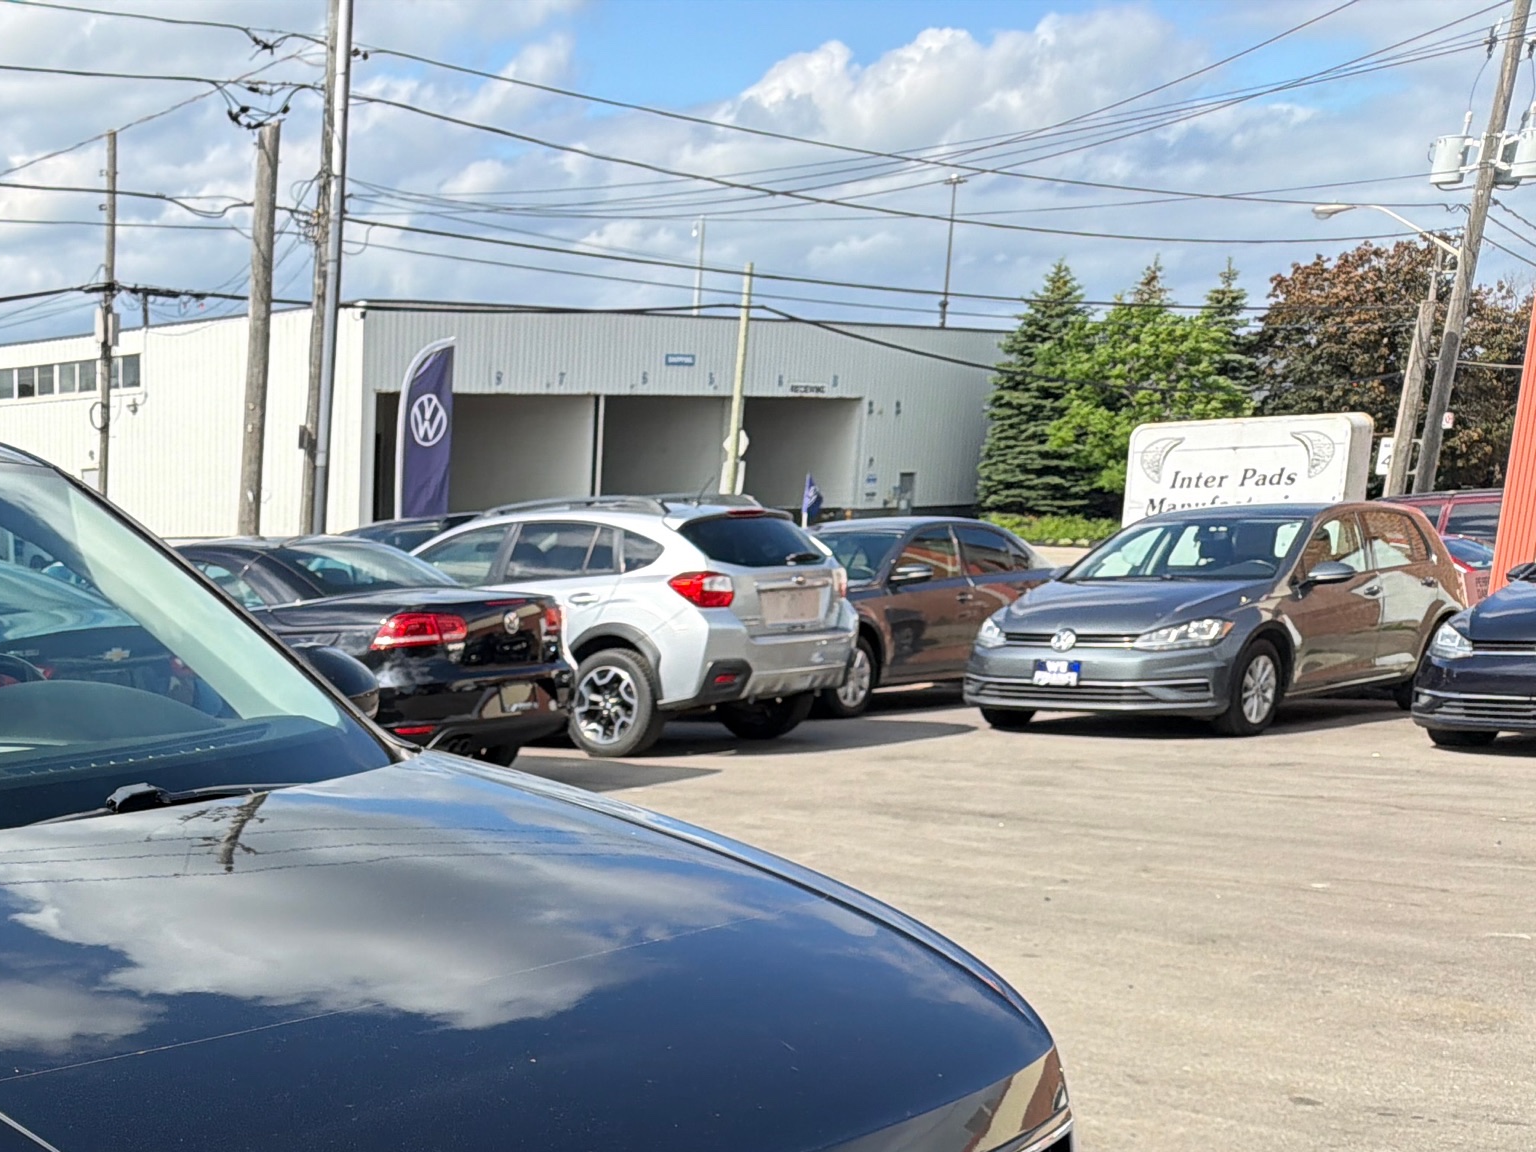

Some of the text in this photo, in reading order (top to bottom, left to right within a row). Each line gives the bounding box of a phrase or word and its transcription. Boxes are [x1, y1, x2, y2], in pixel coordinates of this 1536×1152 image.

[411, 394, 447, 447] VW
[1169, 467, 1298, 490] Inter Pads
